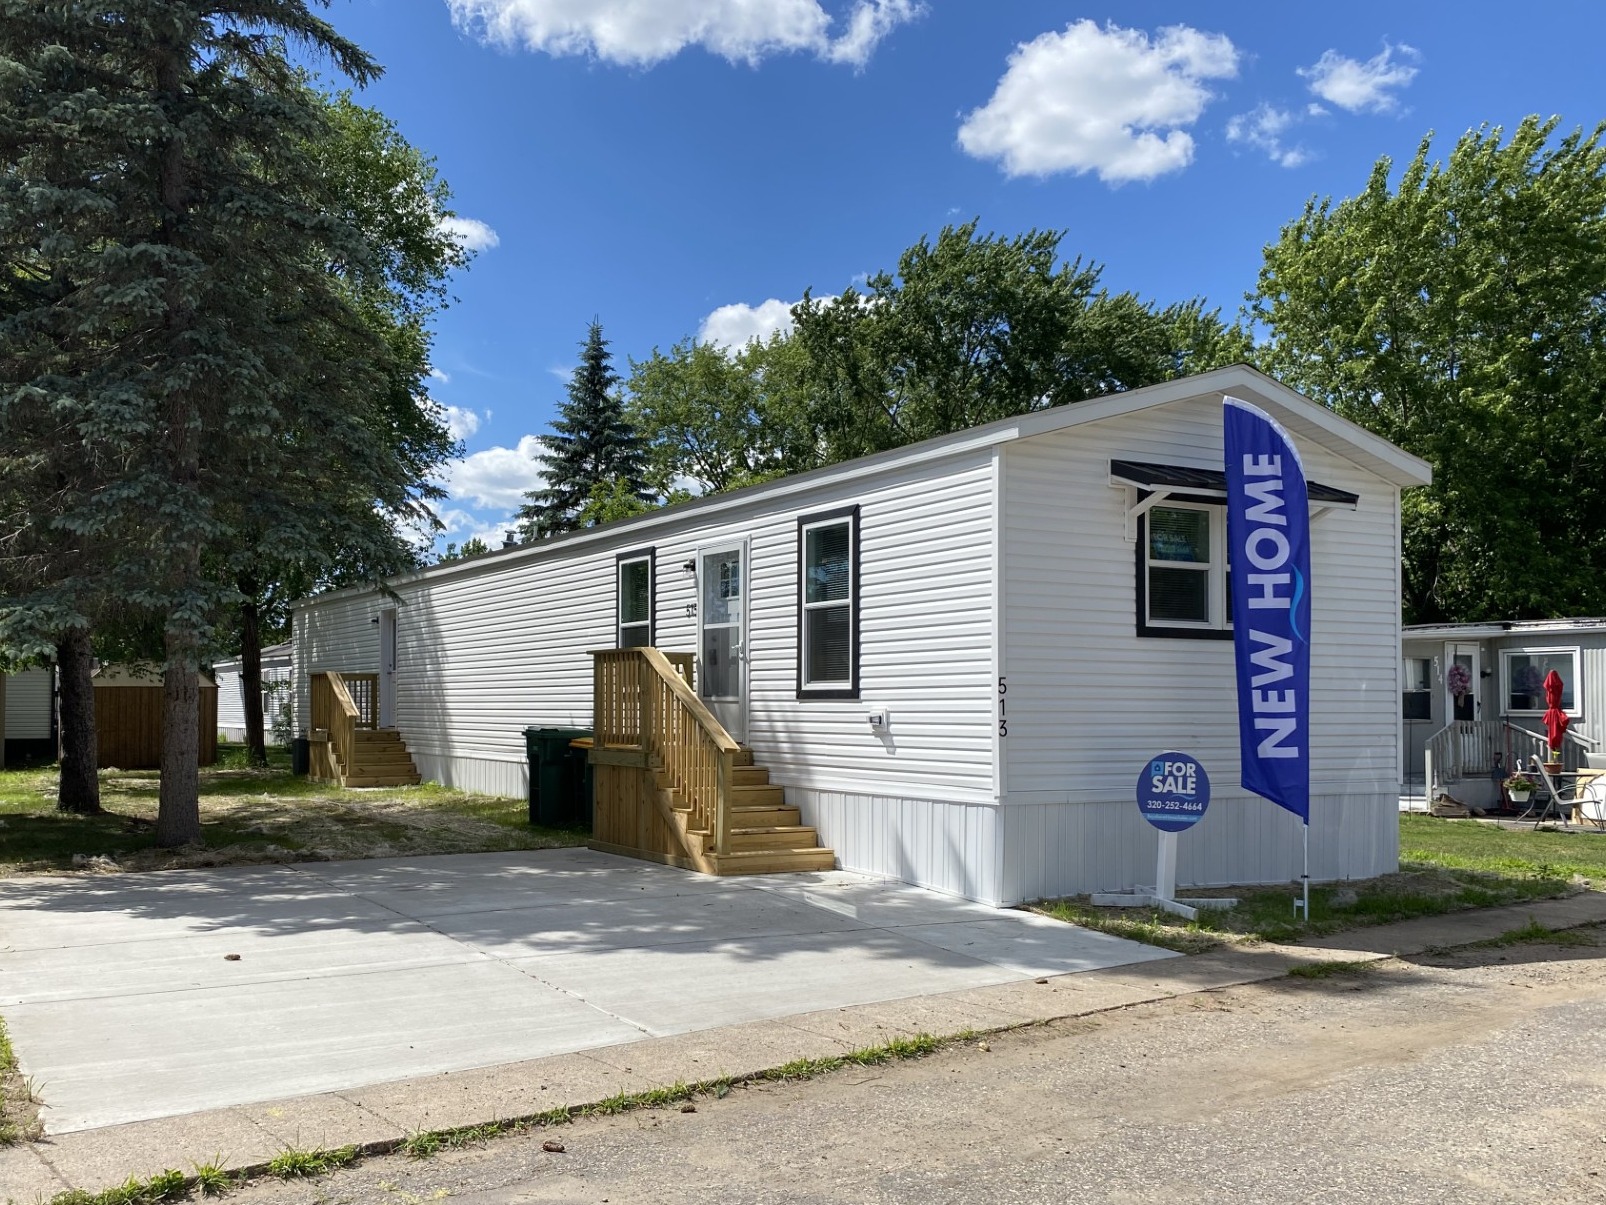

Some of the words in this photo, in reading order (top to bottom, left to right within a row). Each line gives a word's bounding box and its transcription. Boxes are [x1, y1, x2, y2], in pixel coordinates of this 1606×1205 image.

[1243, 453, 1291, 609] HOME
[1433, 655, 1443, 685] 514
[998, 676, 1008, 738] 513
[1249, 628, 1299, 759] NEW
[1164, 761, 1196, 777] FOR
[1151, 775, 1197, 795] SALE
[1146, 800, 1203, 811] 320-252-4664
